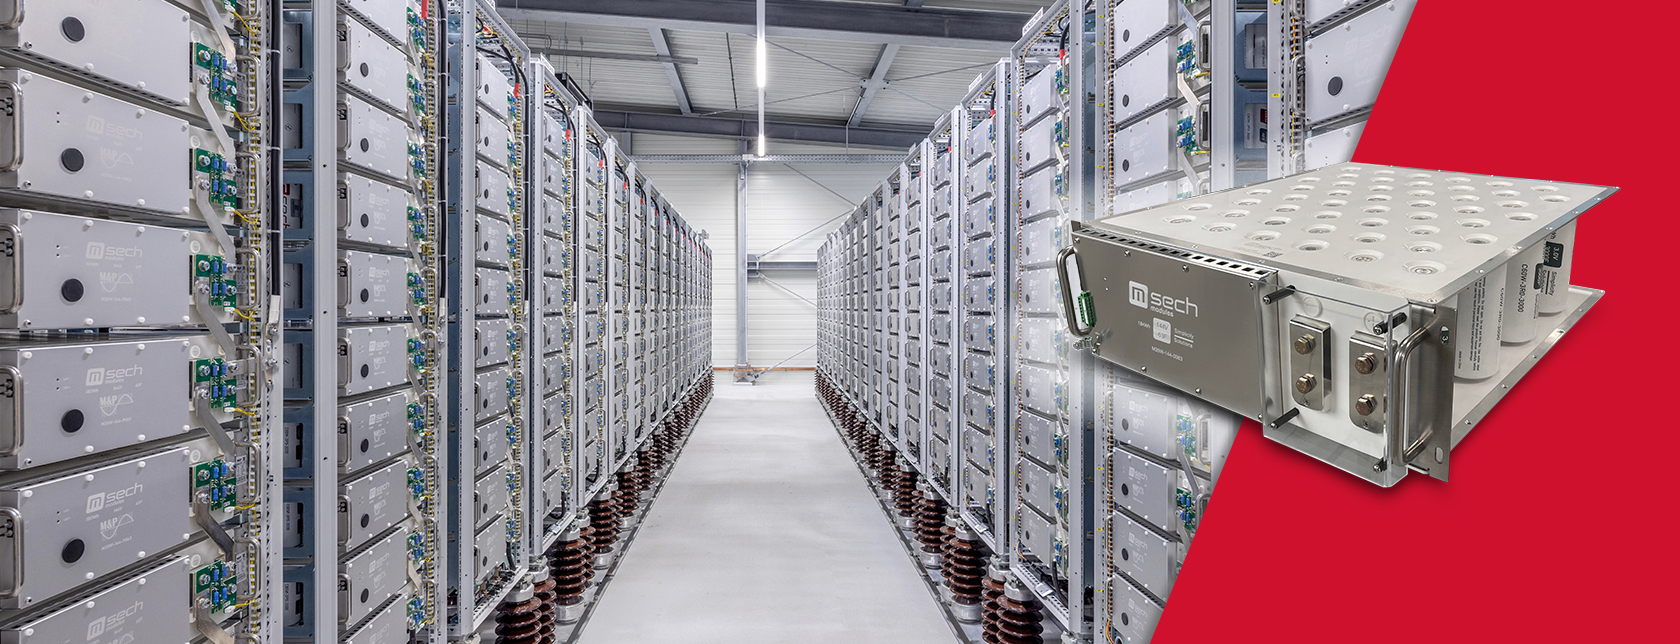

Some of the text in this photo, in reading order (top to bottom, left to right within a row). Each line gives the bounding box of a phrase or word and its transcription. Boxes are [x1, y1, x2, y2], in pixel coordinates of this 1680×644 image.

[106, 122, 143, 140] sech
[106, 245, 143, 258] sech
[100, 272, 117, 282] M&P
[1548, 271, 1557, 296] Simplicity
[1150, 292, 1198, 317] sech
[1150, 305, 1174, 317] modules
[1156, 322, 1169, 330] 144V
[1174, 327, 1195, 340] Simplicity
[1174, 337, 1194, 348] Solutions
[106, 364, 143, 379] sech
[100, 395, 117, 406] M&P
[106, 482, 143, 503] sech
[100, 517, 118, 530] M&P
[106, 600, 144, 626] sech
